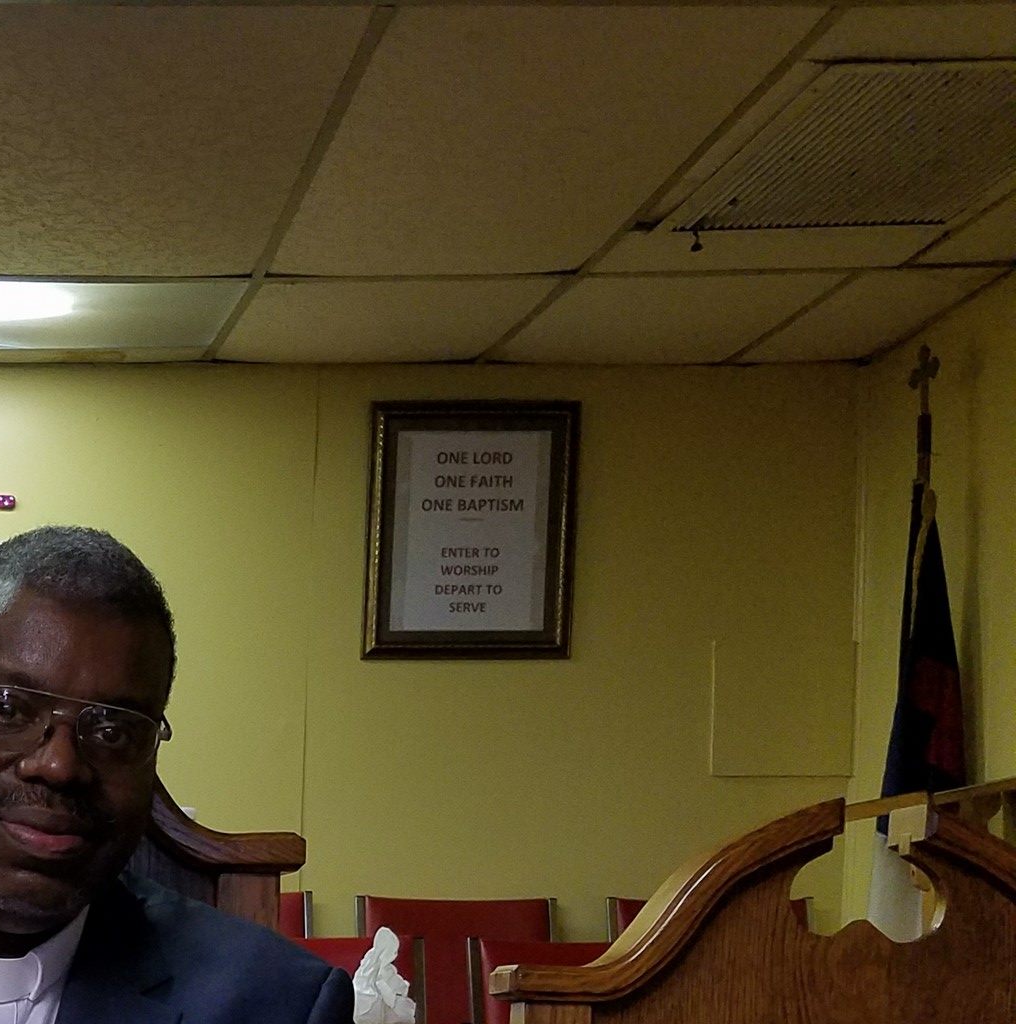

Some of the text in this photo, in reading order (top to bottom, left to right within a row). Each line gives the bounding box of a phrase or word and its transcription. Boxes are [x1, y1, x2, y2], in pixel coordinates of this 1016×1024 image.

[436, 451, 513, 465] ONE LORD
[434, 475, 513, 488] ONE FAITH
[421, 499, 524, 512] ONE BAPTISM
[441, 547, 500, 559] ENTER TO
[440, 565, 499, 576] WORSHIP
[434, 585, 503, 595] DEPART TO
[448, 602, 486, 613] SERVE
